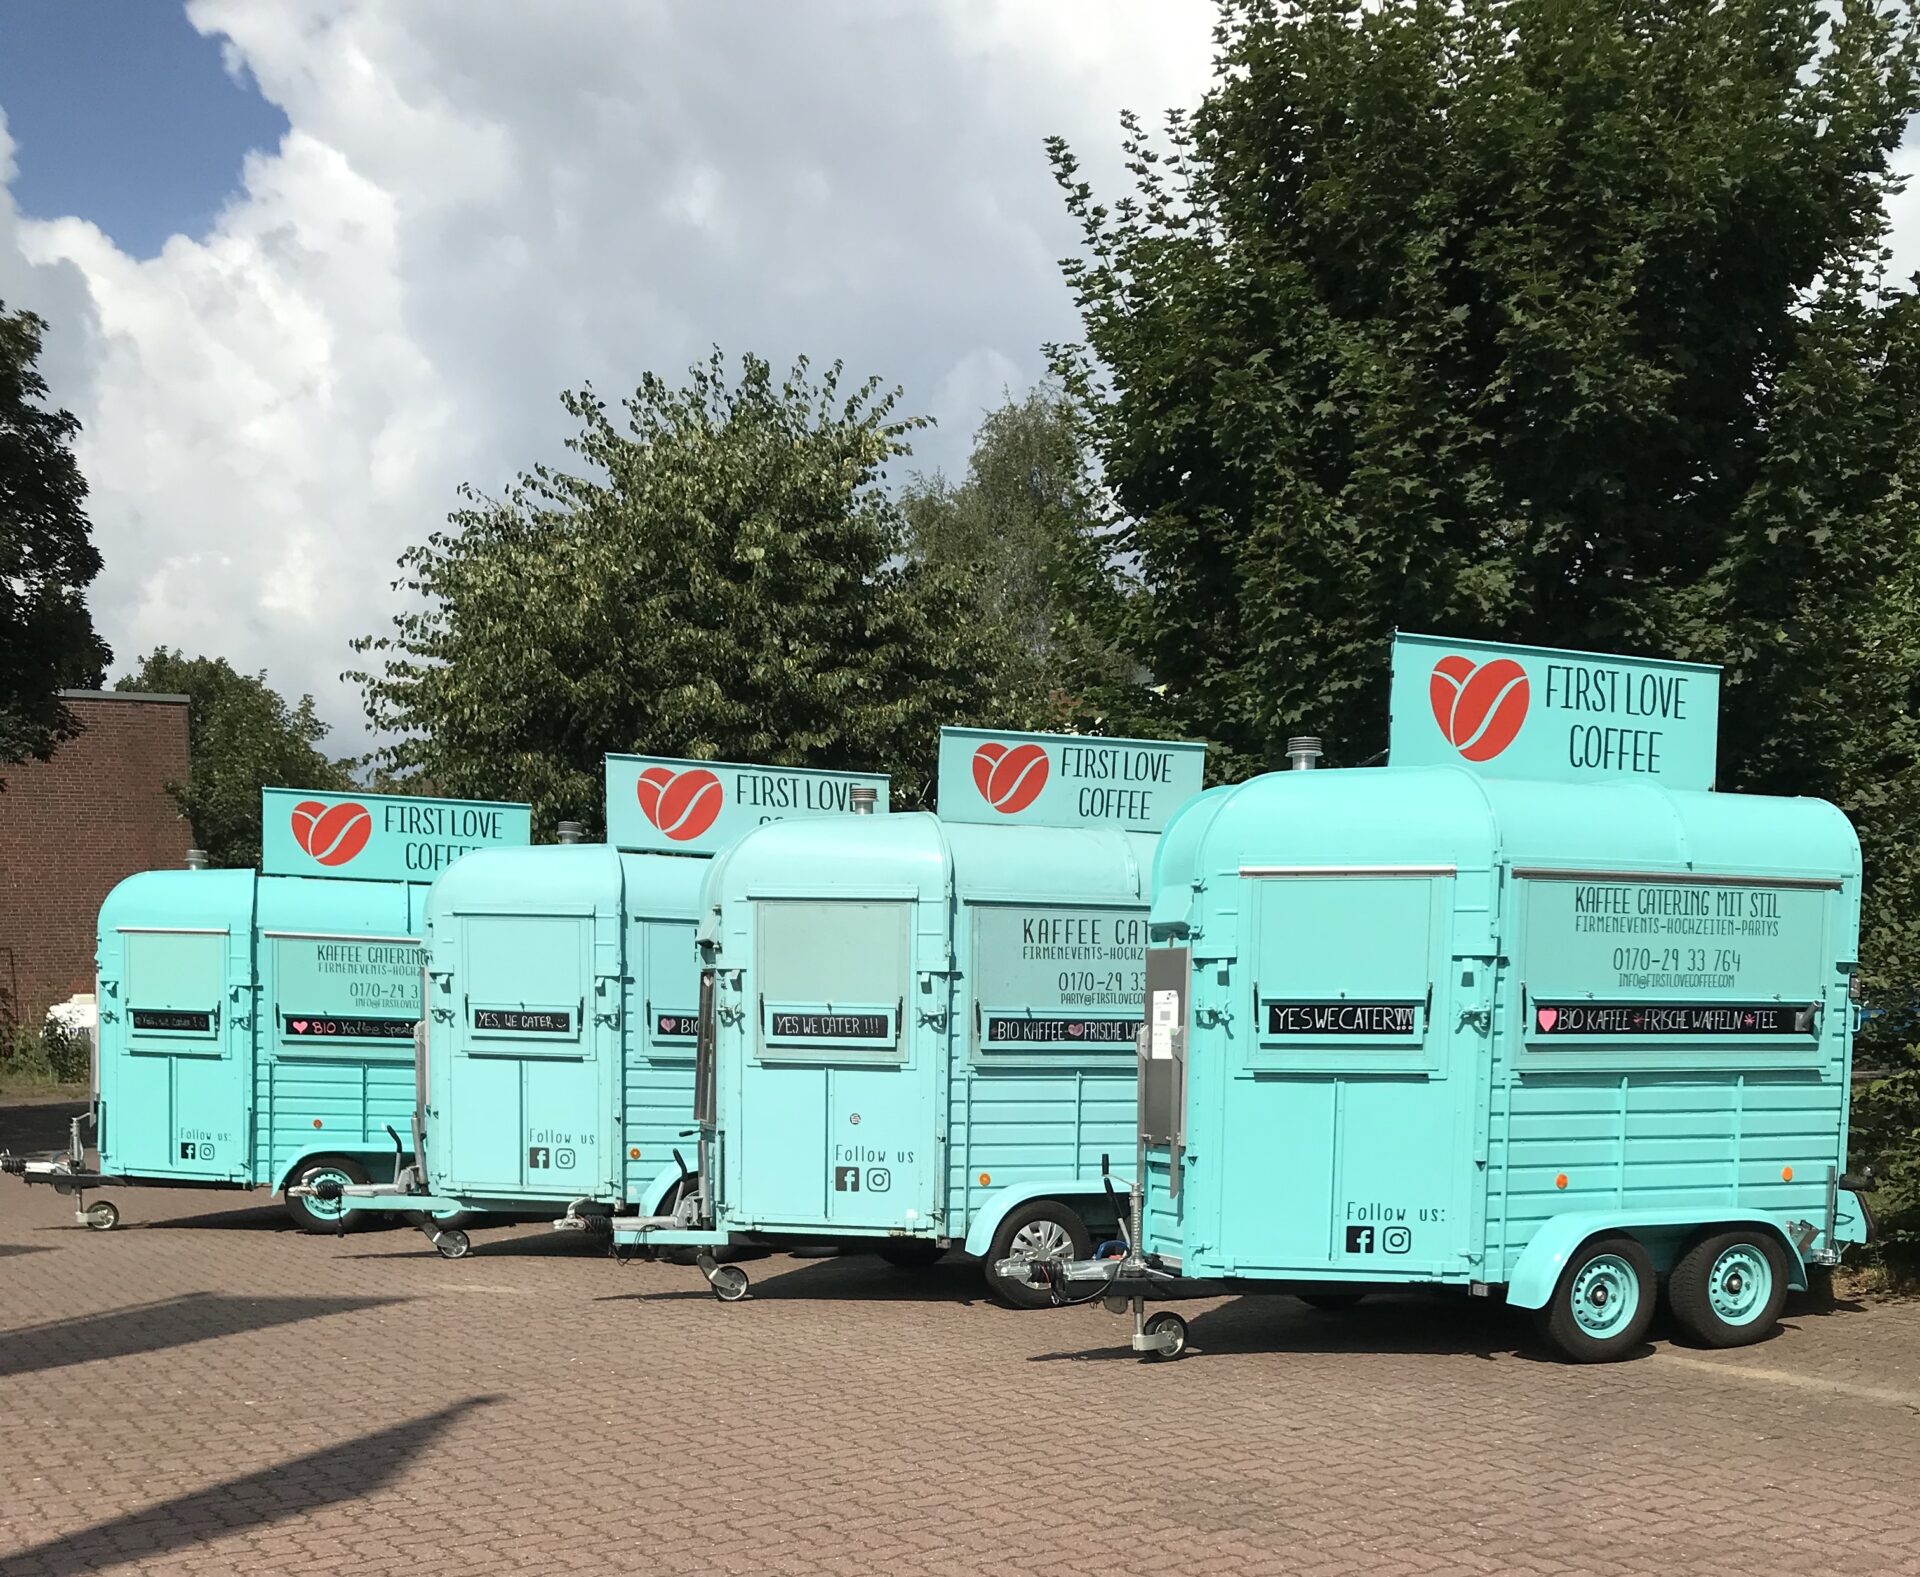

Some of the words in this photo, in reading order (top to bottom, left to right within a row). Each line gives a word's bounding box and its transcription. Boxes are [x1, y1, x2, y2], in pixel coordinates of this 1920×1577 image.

[1546, 665, 1621, 712] FIRST
[1626, 672, 1689, 720] LOVE
[1569, 724, 1664, 774] COFFEE
[1061, 747, 1120, 780] FIRST
[1124, 751, 1175, 783] LOVE
[736, 774, 800, 808] FIRST
[1079, 787, 1153, 820] COFFEE
[385, 805, 446, 835] FIRST
[451, 809, 504, 839] LOVE
[406, 842, 484, 871] COFF
[1575, 886, 1632, 914] KAFFEE
[1638, 888, 1710, 917] CATERING
[1717, 891, 1744, 917] MIT
[1750, 892, 1782, 918] STIL
[1023, 918, 1102, 945] KAFFEE
[1575, 915, 1779, 937] FIRMENEVENTS-HOCHZEITEN-PARTYS
[317, 944, 363, 962] KAFFEE
[1613, 947, 1679, 971] 0170-29
[1687, 948, 1706, 972] 33
[1714, 949, 1741, 972] 764
[350, 982, 404, 999] 0170-29
[1059, 972, 1122, 991] 0170-29
[1618, 973, 1735, 989] INFO@FIRSTLOVECOFFEE.COM
[312, 1021, 337, 1034] BIO
[504, 1013, 518, 1027] WE
[521, 1015, 554, 1029] CATER
[777, 1016, 799, 1034] YES
[802, 1017, 819, 1034] WE
[821, 1017, 860, 1035] CATER
[1586, 1009, 1632, 1031] KAFFEE
[1643, 1009, 1689, 1031] FRISCHE
[1692, 1010, 1743, 1031] WAFFELN
[1755, 1010, 1778, 1029] TEE
[998, 1021, 1020, 1040] BIO
[1023, 1021, 1065, 1041] KAFFEE
[1084, 1021, 1122, 1040] FRISCHE
[180, 1127, 212, 1140] Follow
[529, 1128, 572, 1144] Follow
[580, 1134, 595, 1145] us
[835, 1144, 886, 1162] Follow
[897, 1151, 914, 1163] us
[1346, 1201, 1406, 1221] Follow
[1419, 1208, 1446, 1222] us:
